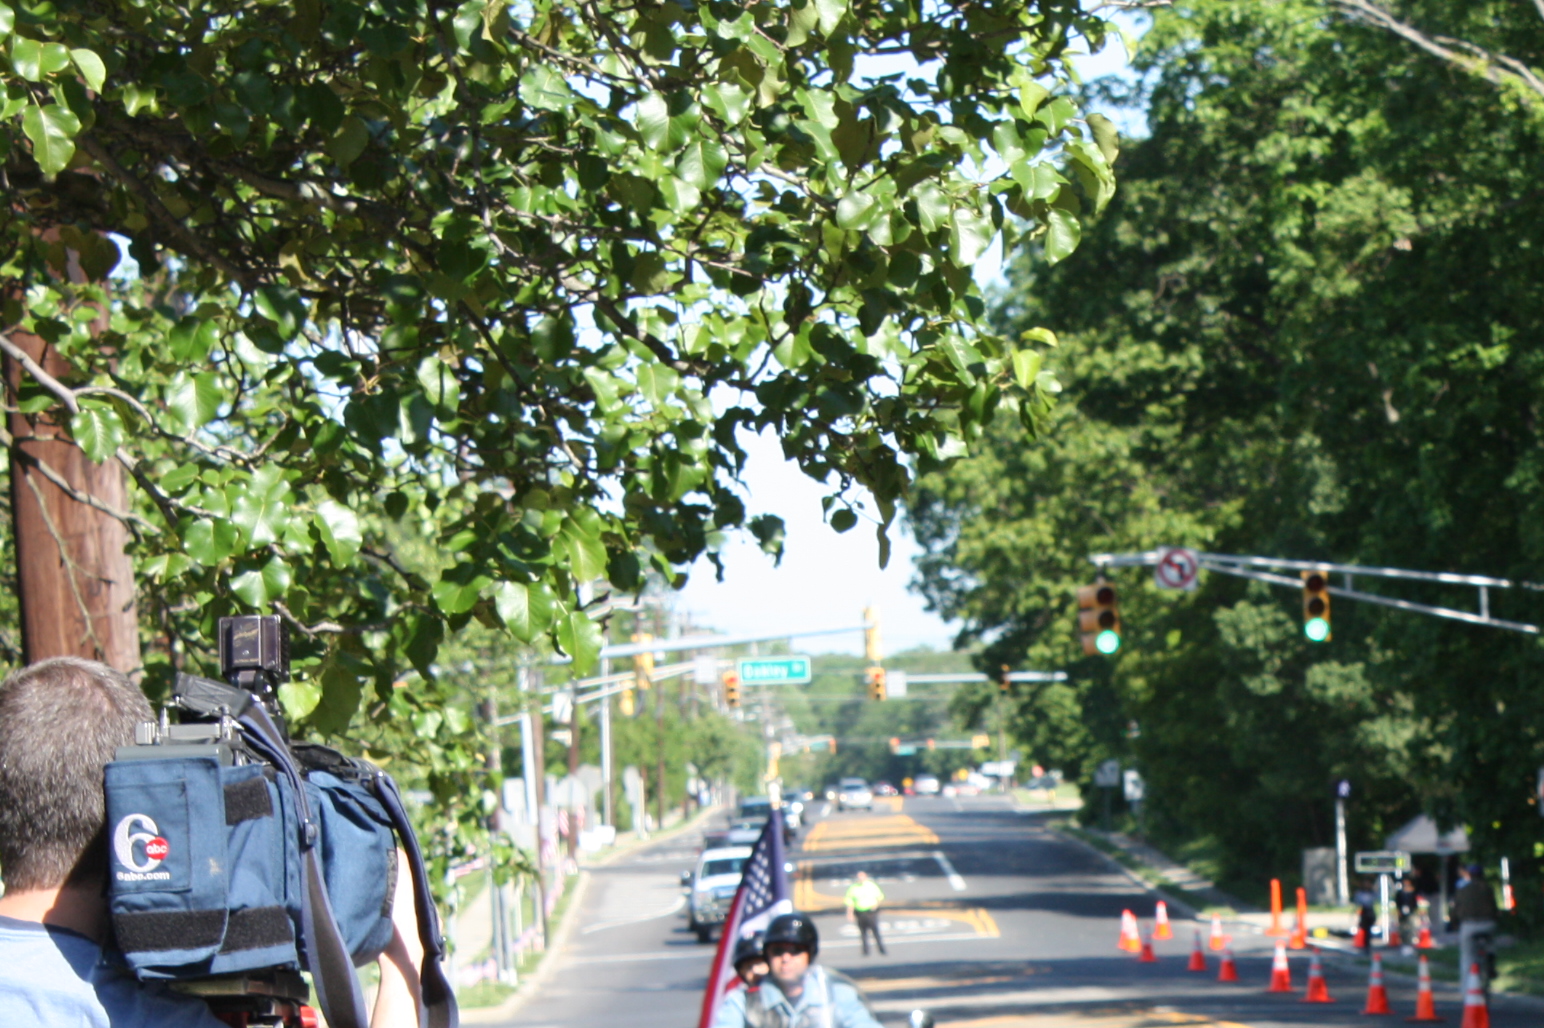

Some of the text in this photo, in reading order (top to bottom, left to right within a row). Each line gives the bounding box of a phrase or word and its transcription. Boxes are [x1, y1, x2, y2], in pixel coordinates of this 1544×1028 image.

[114, 813, 162, 872] 6
[146, 843, 167, 854] abc
[116, 872, 170, 881] 6abc.com
